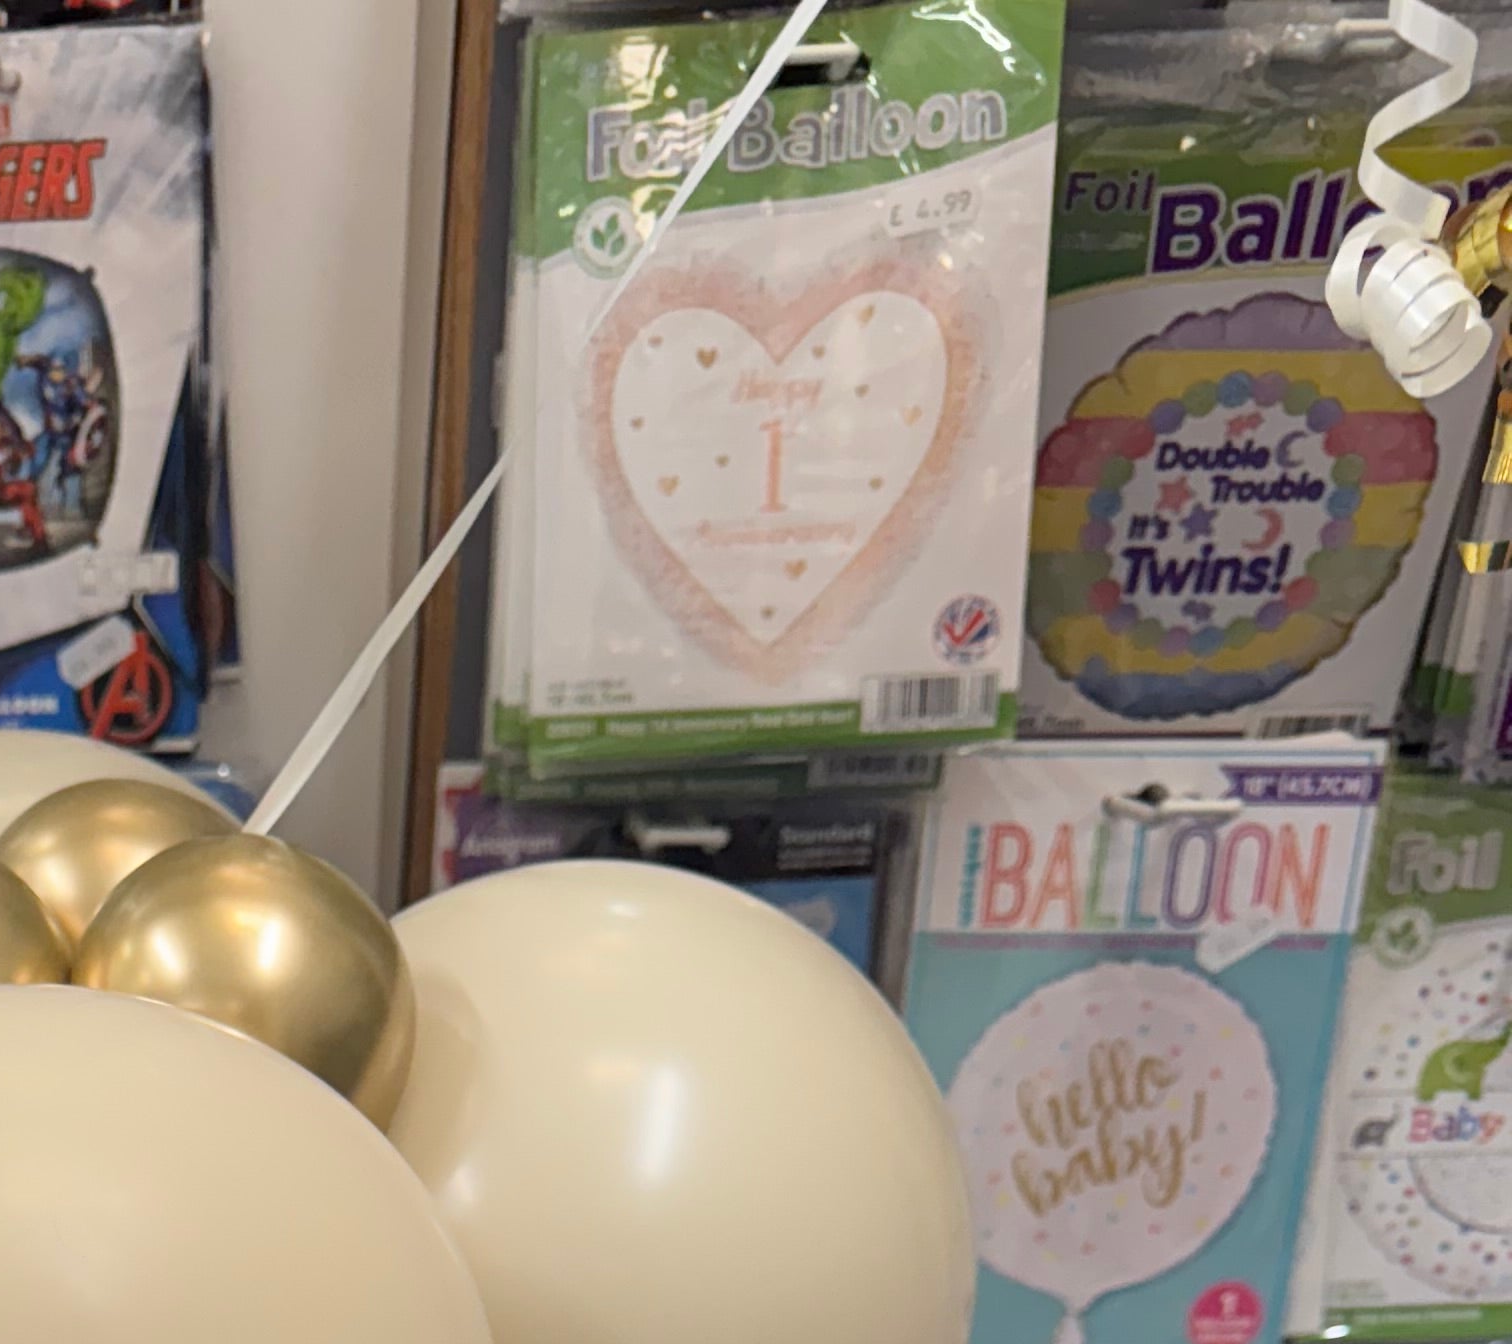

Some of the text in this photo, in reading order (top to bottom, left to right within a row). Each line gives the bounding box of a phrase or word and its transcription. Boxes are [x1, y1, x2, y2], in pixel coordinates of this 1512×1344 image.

[728, 84, 1008, 172] Balloon
[1062, 168, 1158, 214] Foil
[1155, 438, 1271, 472] Double
[1211, 472, 1326, 503] Trouble
[1128, 513, 1171, 541] It's
[1120, 542, 1292, 596] Twins!
[980, 820, 1331, 928] BALLOON
[1387, 831, 1503, 894] Foil
